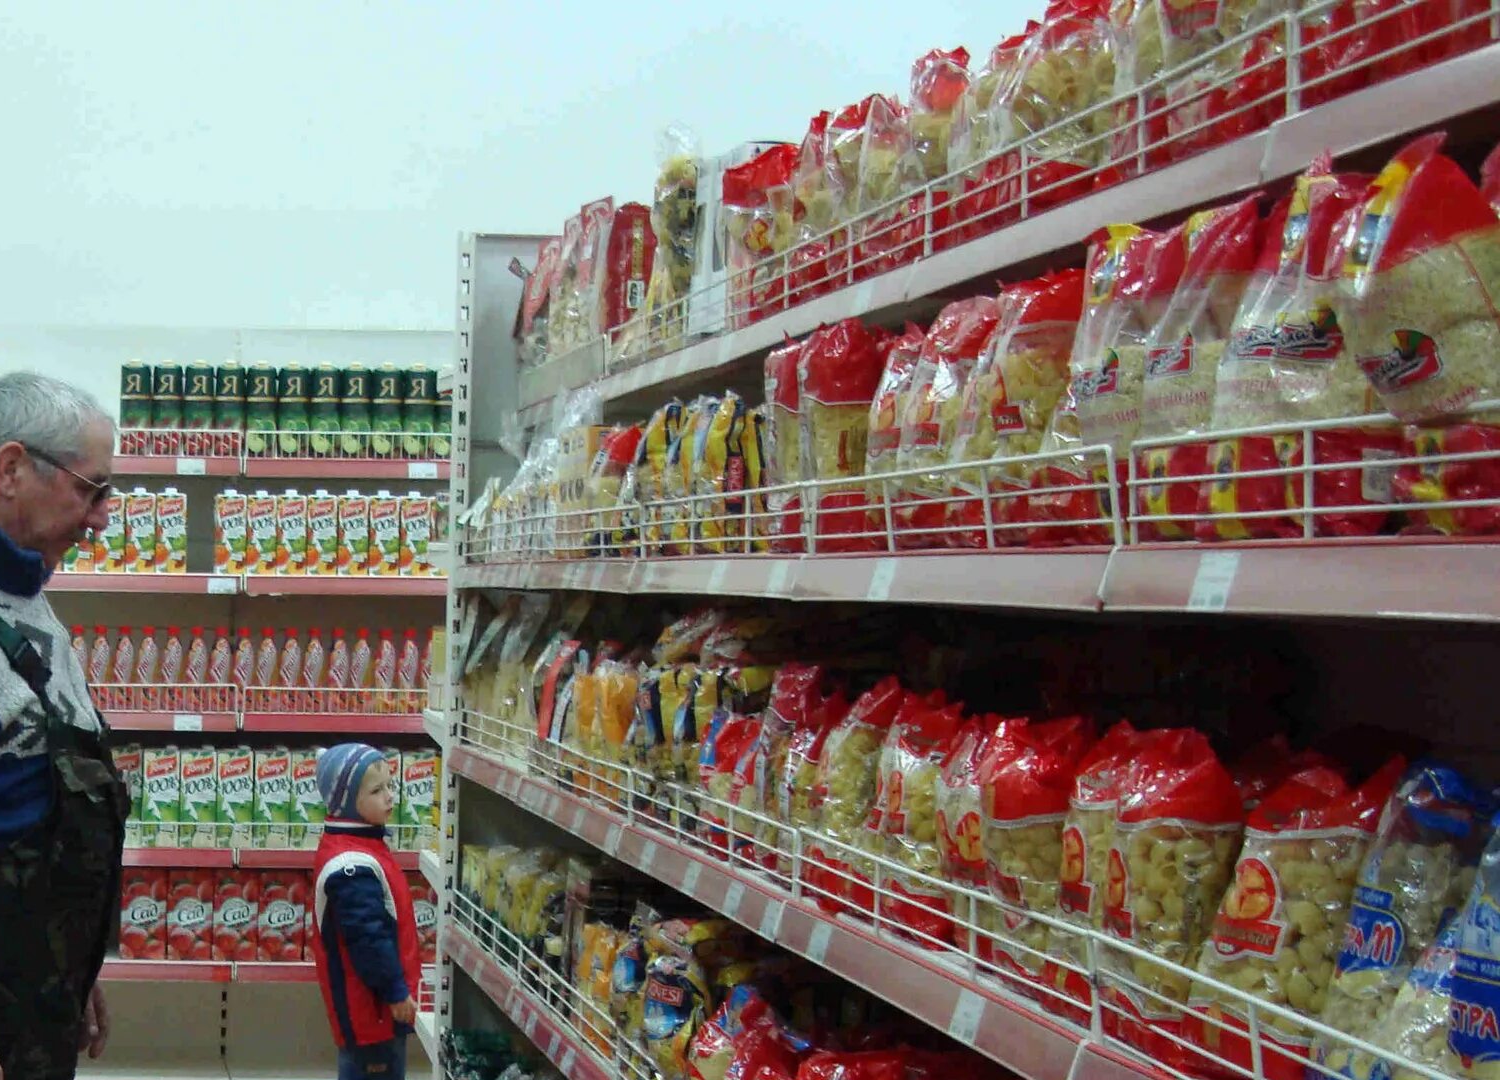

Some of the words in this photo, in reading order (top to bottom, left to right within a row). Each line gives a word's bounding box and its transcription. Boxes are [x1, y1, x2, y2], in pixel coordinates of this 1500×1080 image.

[126, 373, 141, 394] Я
[160, 373, 175, 394] Я
[192, 374, 207, 395] Я
[223, 374, 238, 394] Я
[254, 375, 269, 395] Я
[287, 376, 301, 396] Я
[319, 376, 334, 396] Я
[348, 376, 363, 396] Я
[380, 377, 395, 397] Я
[411, 378, 426, 398] Я
[131, 903, 158, 921] Сад
[177, 904, 204, 922] Сад
[222, 905, 250, 922] Сад
[267, 906, 295, 924] Сад
